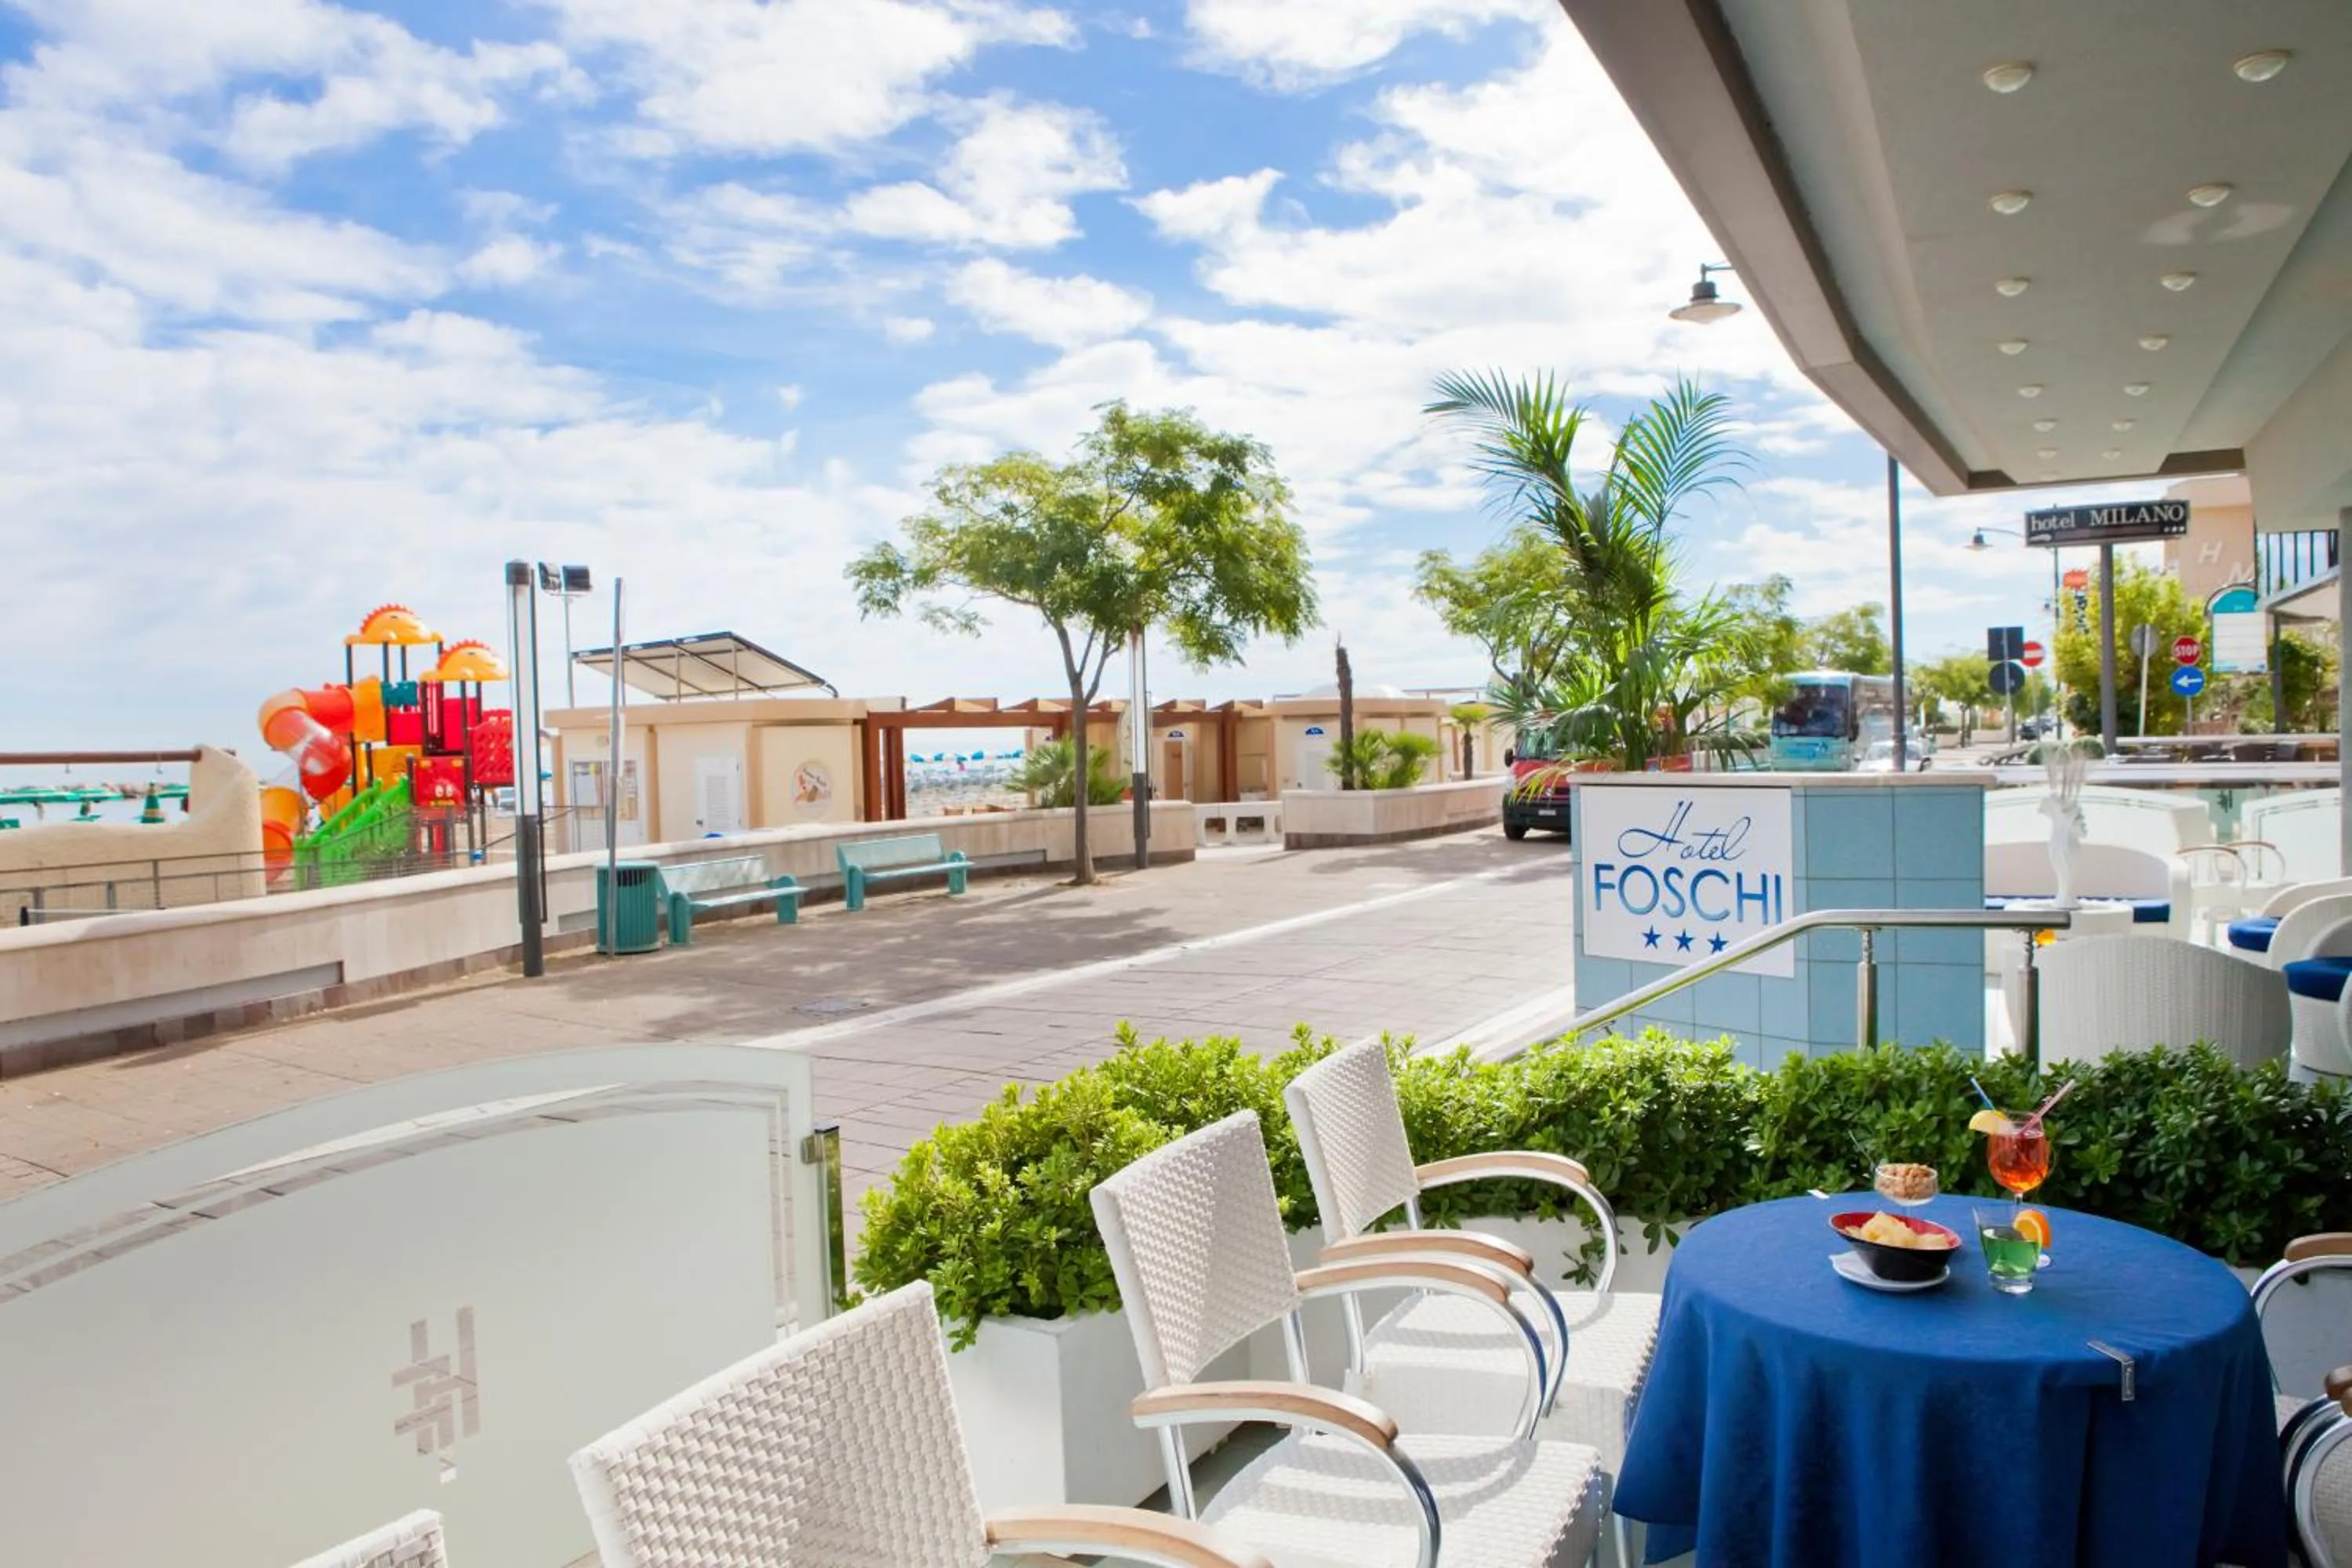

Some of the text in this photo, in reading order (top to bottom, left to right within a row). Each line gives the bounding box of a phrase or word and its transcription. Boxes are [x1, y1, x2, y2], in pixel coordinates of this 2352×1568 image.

[2031, 503, 2185, 532] hotel MILANO
[2175, 644, 2199, 657] STOP
[1617, 800, 1751, 861] Hotel
[1593, 863, 1782, 926] FOSCHI
